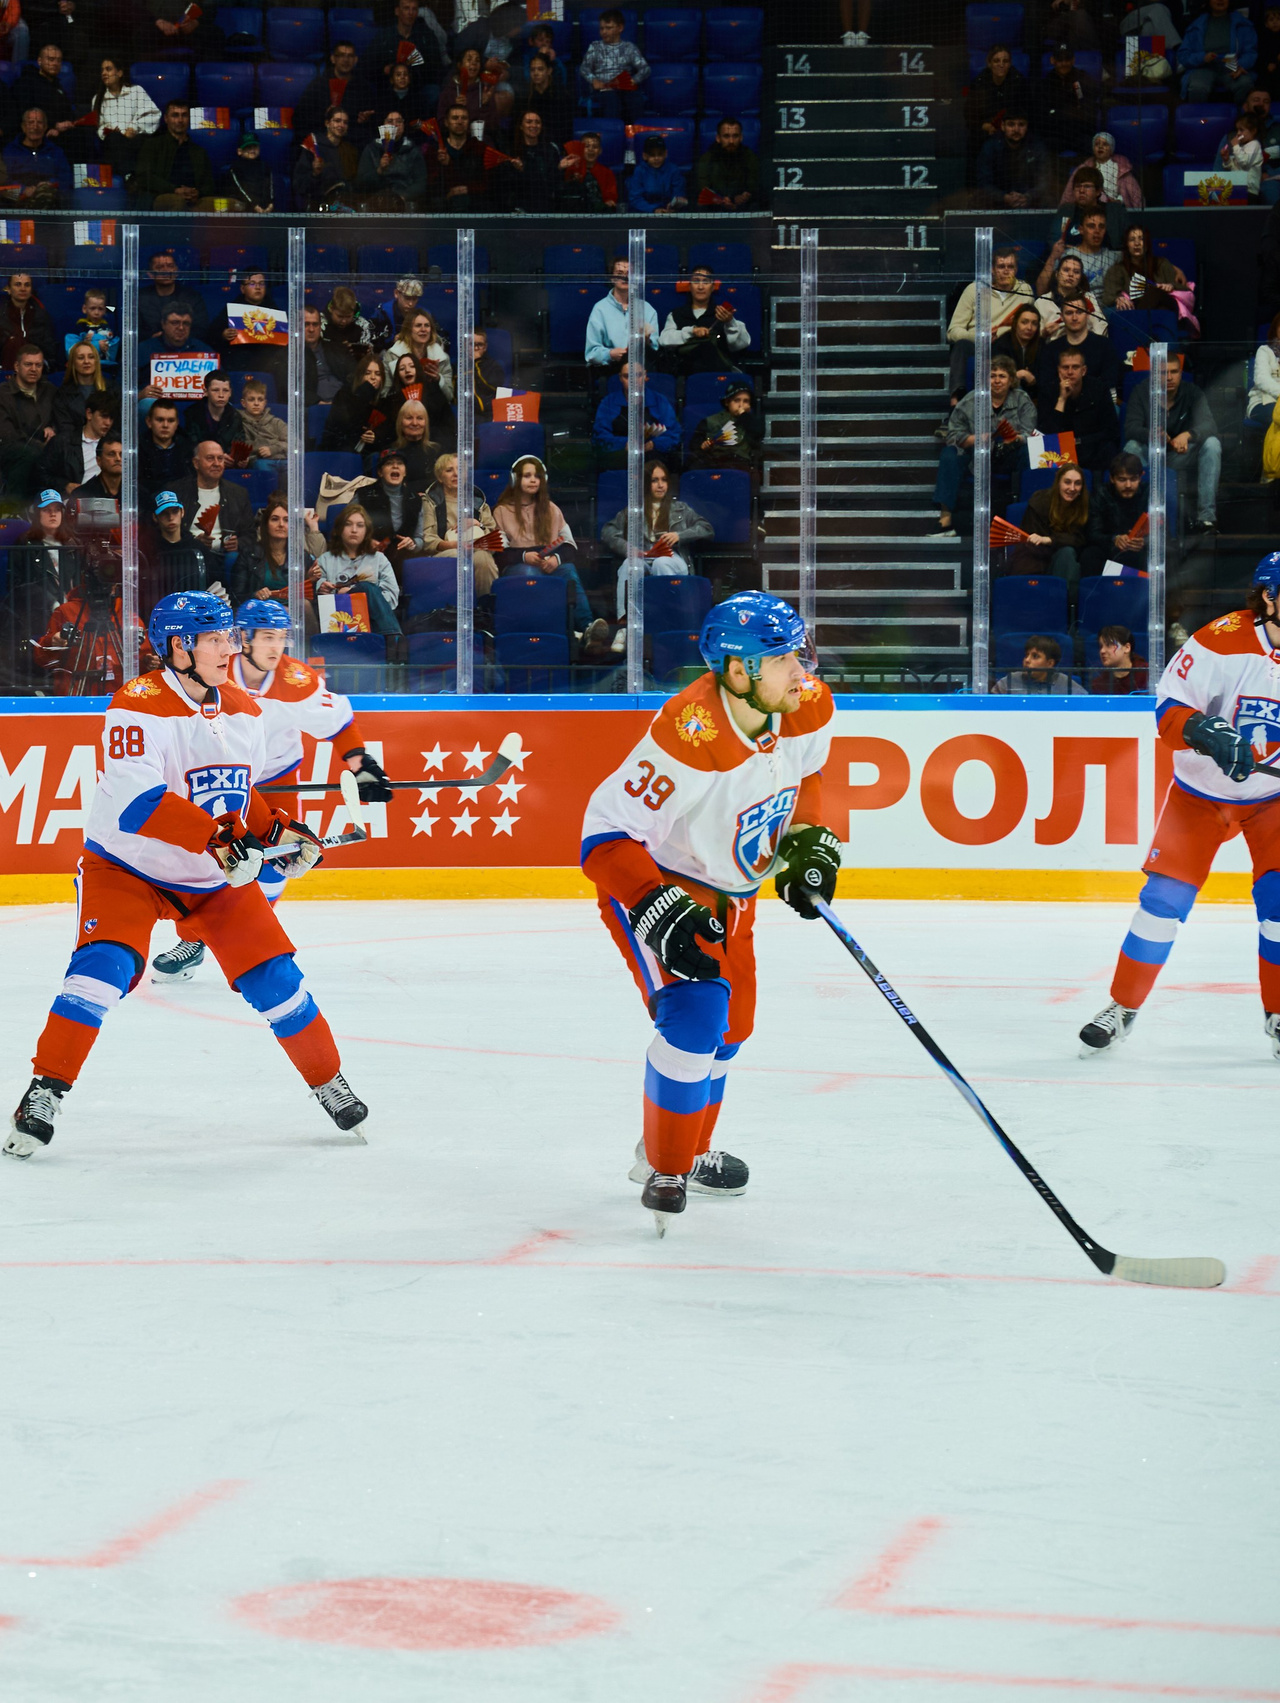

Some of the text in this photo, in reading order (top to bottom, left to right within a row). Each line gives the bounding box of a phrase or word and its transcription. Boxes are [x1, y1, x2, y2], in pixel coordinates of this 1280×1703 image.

[785, 52, 925, 74] 14 14
[778, 106, 929, 129] 13 13
[776, 165, 929, 188] 12 12
[777, 224, 928, 249] 11 11
[154, 373, 205, 390] ВПЕРЁ
[109, 726, 145, 760] 88
[190, 769, 249, 793] СХЛ
[625, 760, 676, 811] 39
[740, 788, 798, 835] СХЛ
